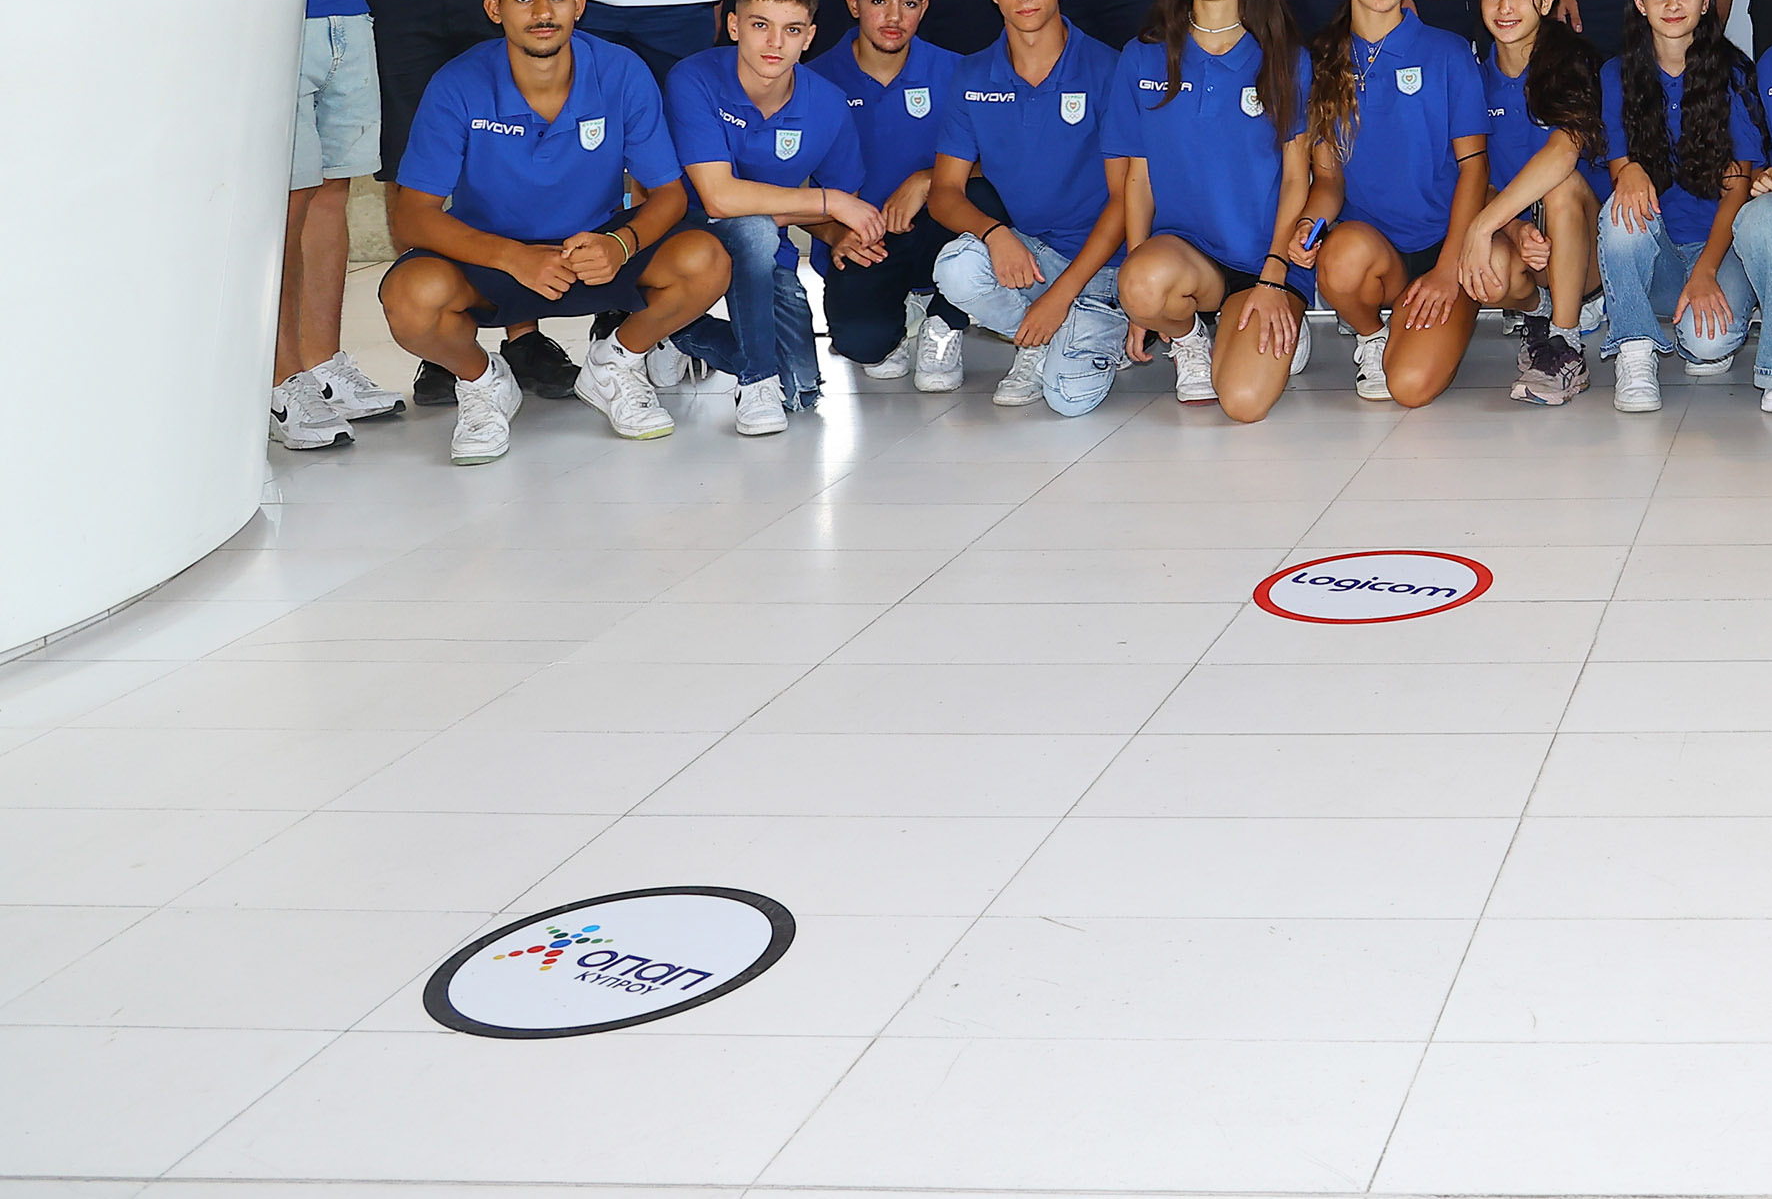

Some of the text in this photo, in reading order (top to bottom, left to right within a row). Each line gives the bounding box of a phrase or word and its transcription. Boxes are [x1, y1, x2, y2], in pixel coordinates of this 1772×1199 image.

[1138, 79, 1194, 92] GIVOA
[964, 90, 1016, 103] GIVOVA
[471, 118, 526, 137] GIVOVA
[573, 971, 661, 996] ΚΥΠΡΟΥ
